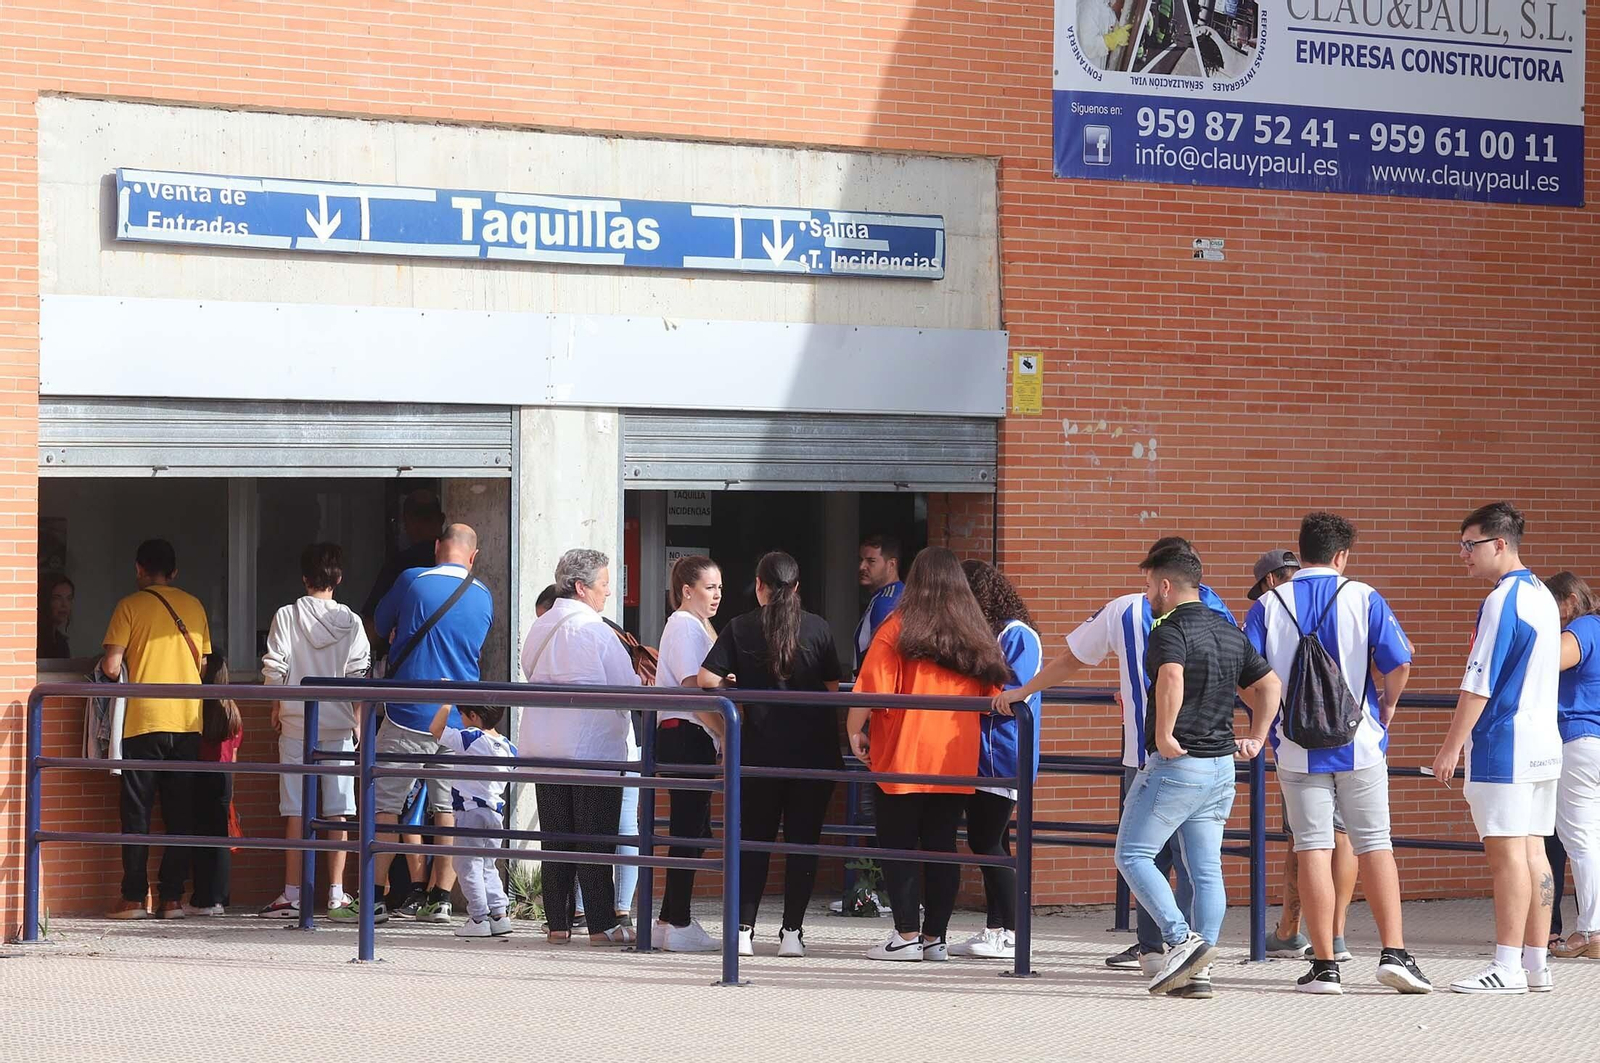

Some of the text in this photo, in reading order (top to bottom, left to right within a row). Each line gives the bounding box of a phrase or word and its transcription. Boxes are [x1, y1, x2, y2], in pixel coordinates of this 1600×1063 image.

[1520, 0, 1573, 42] S.L.
[1066, 26, 1103, 82] FONTANERÍA
[1212, 10, 1268, 92] REFORMAS INTEGRALES
[1296, 39, 1564, 83] EMPRESA CONSTRUCTORA
[1130, 76, 1204, 92] SEÑALIZACIÓN VIAL
[1136, 107, 1195, 139] 959
[1205, 111, 1244, 142] 87
[1254, 115, 1292, 145] 52
[1301, 118, 1338, 148] 41
[1370, 122, 1425, 154] 959
[1434, 127, 1470, 157] 61
[1479, 130, 1515, 160] 00
[1525, 133, 1558, 162] 11
[1136, 143, 1338, 177] info@clauypaul.es
[1372, 164, 1560, 192] www.clauypaul.es
[146, 180, 247, 206] Venta de
[147, 210, 249, 236] Entradas
[451, 196, 660, 255] Taquillas
[810, 217, 869, 239] Salida
[808, 249, 941, 272] T. Incidencias
[673, 490, 706, 500] TAQUILLA
[668, 506, 711, 516] INCIDENCIAS
[669, 551, 680, 559] NO
